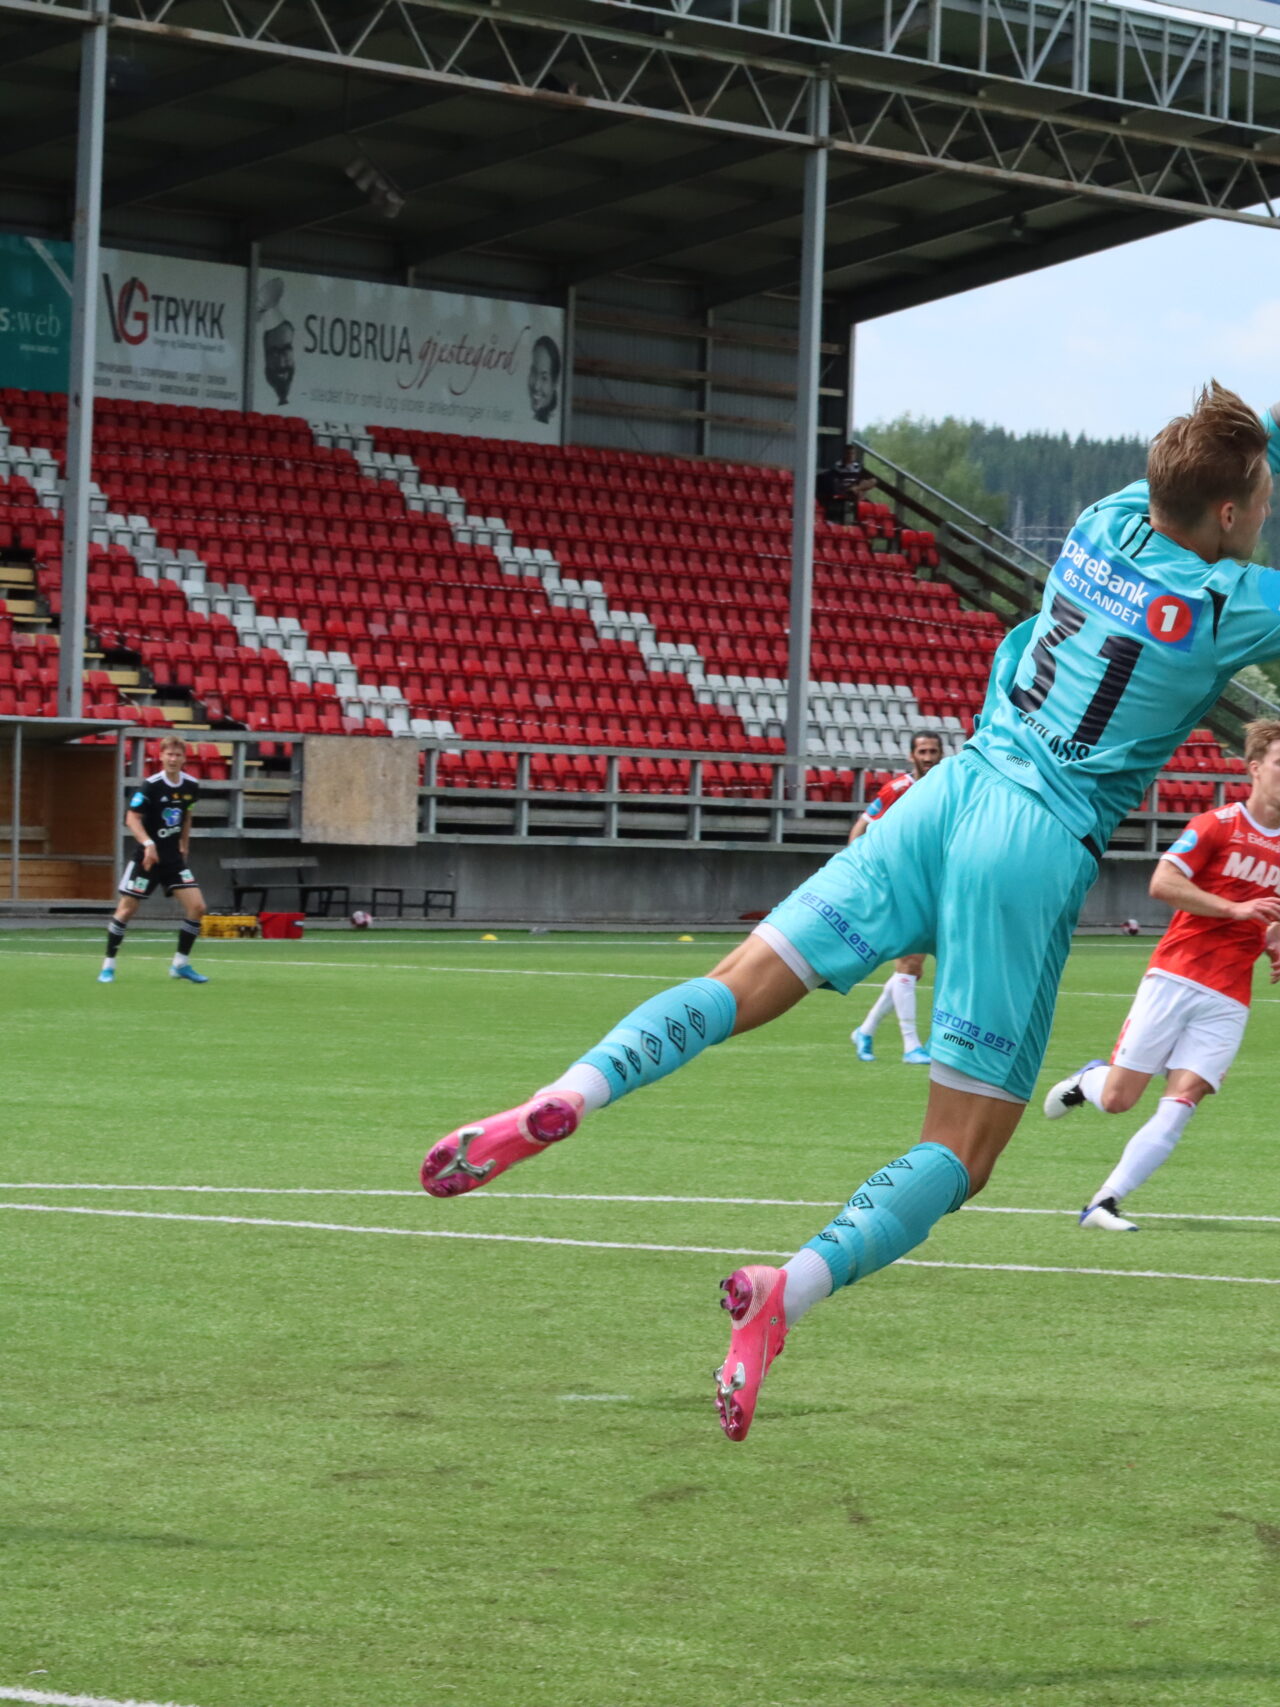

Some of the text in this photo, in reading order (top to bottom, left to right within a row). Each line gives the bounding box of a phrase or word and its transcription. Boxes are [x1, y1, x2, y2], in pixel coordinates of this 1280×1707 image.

[151, 294, 225, 340] TRYKK
[304, 314, 412, 365] SLOBRUA
[1063, 568, 1142, 626] ØSTLANDET
[1160, 605, 1179, 632] 1
[1009, 591, 1145, 746] 31
[1006, 753, 1031, 768] umbro
[800, 891, 877, 961] BETONG ØST
[943, 1032, 975, 1051] umbro
[983, 1031, 1017, 1052] ØST
